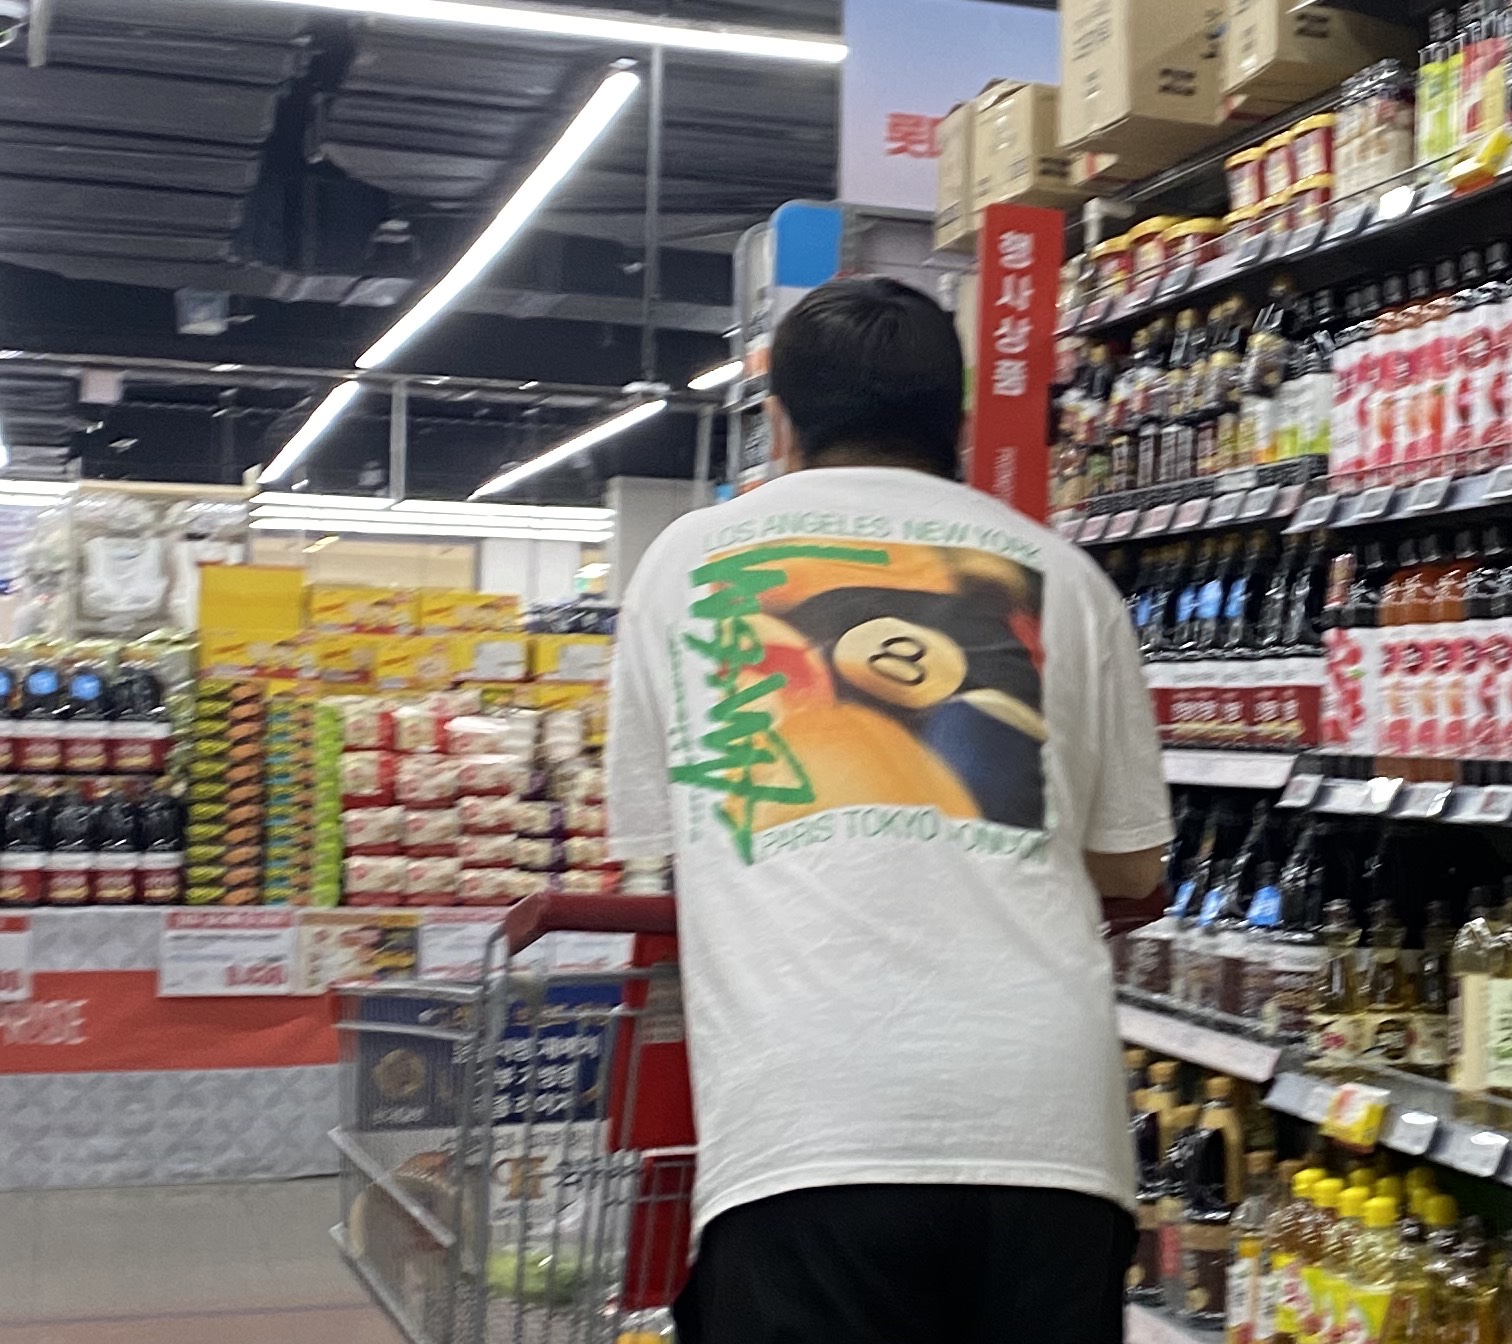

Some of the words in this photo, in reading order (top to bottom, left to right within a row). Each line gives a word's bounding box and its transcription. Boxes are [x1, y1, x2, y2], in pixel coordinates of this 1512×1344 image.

[992, 229, 1037, 398] 행사상품
[703, 518, 755, 554] LOS
[758, 510, 894, 539] ANGELES
[902, 517, 968, 543] NEW
[972, 524, 1043, 566] YORK
[759, 816, 835, 857] PARIS
[842, 805, 940, 842] TOKYO
